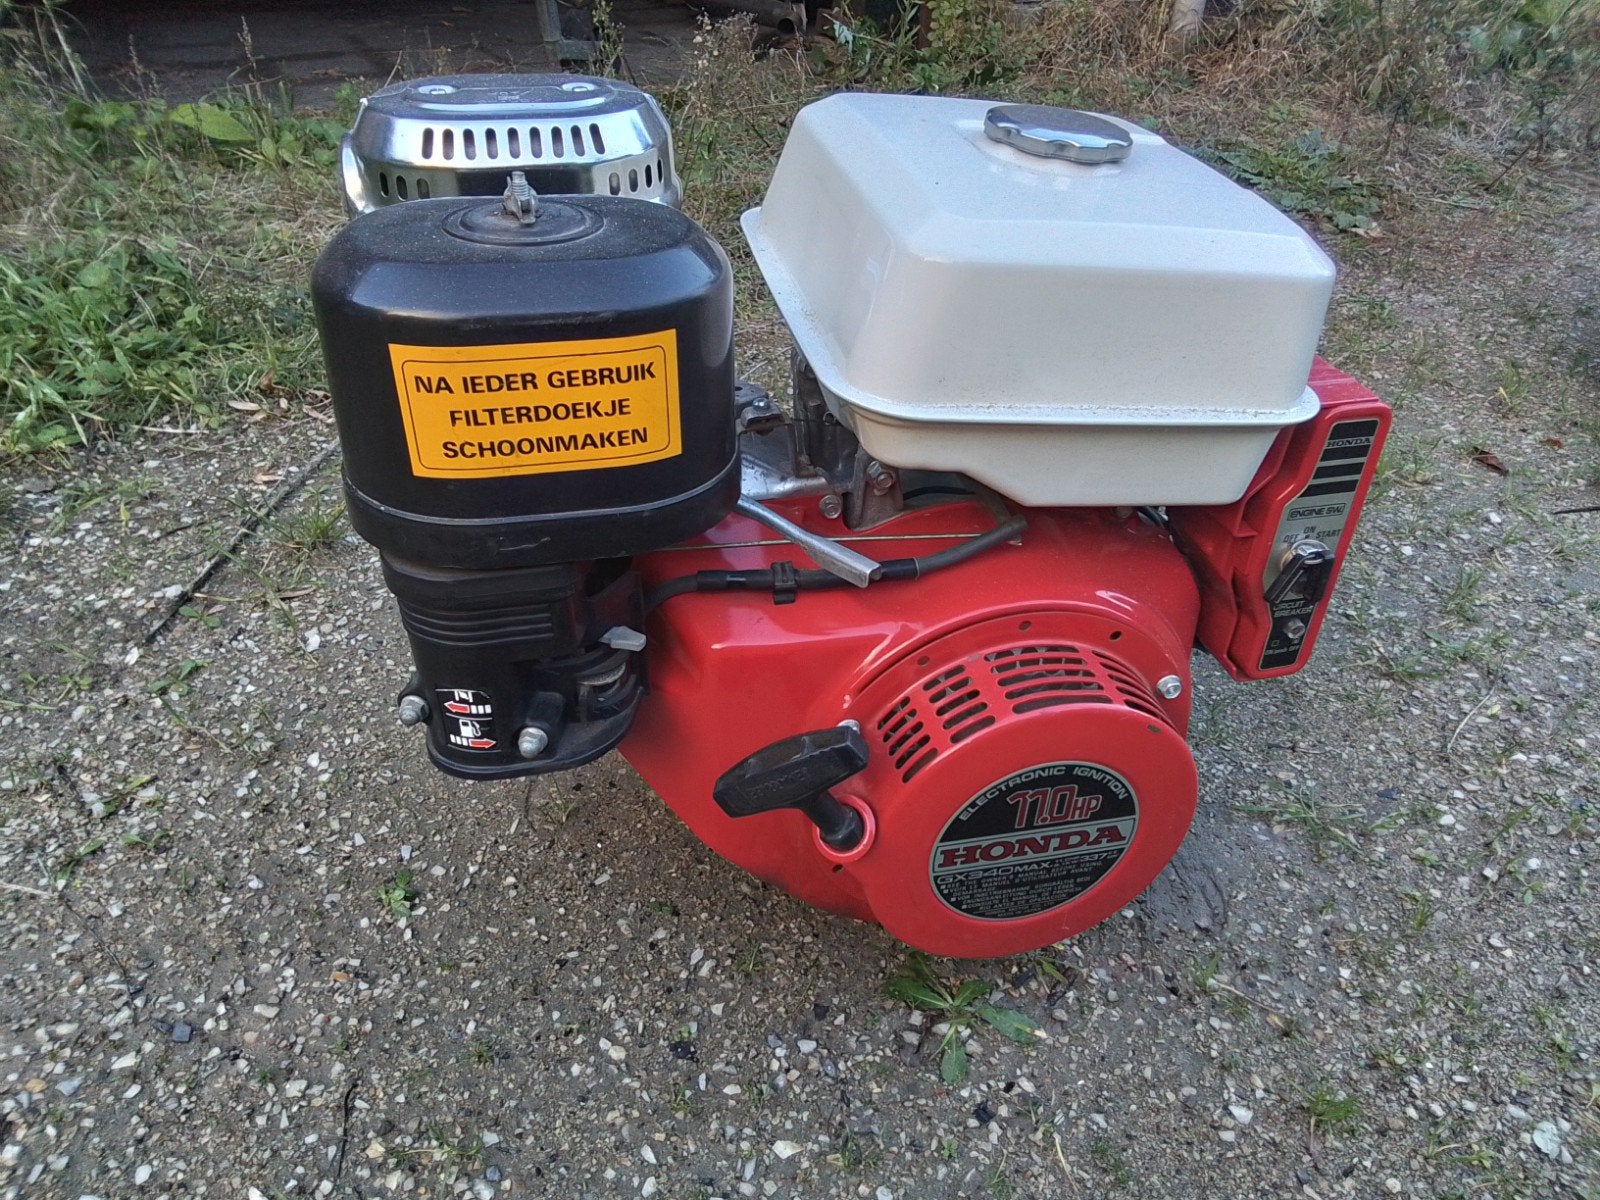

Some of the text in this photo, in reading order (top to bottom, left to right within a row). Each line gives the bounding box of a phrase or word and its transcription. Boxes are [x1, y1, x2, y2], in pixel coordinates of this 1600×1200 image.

[414, 361, 656, 394] NA IEDER GEBRUIK
[449, 398, 631, 427] FILTERDOEKJE
[442, 427, 649, 459] SCHOONMAKEN
[1327, 437, 1370, 448] HONDA
[1290, 507, 1326, 518] ENGINE
[1283, 529, 1343, 543] OFF START
[1303, 526, 1316, 534] ON
[1274, 607, 1312, 618] BREAKER
[959, 766, 1129, 821] ELECTRONIC IGNITION
[938, 825, 1127, 868] HONDA
